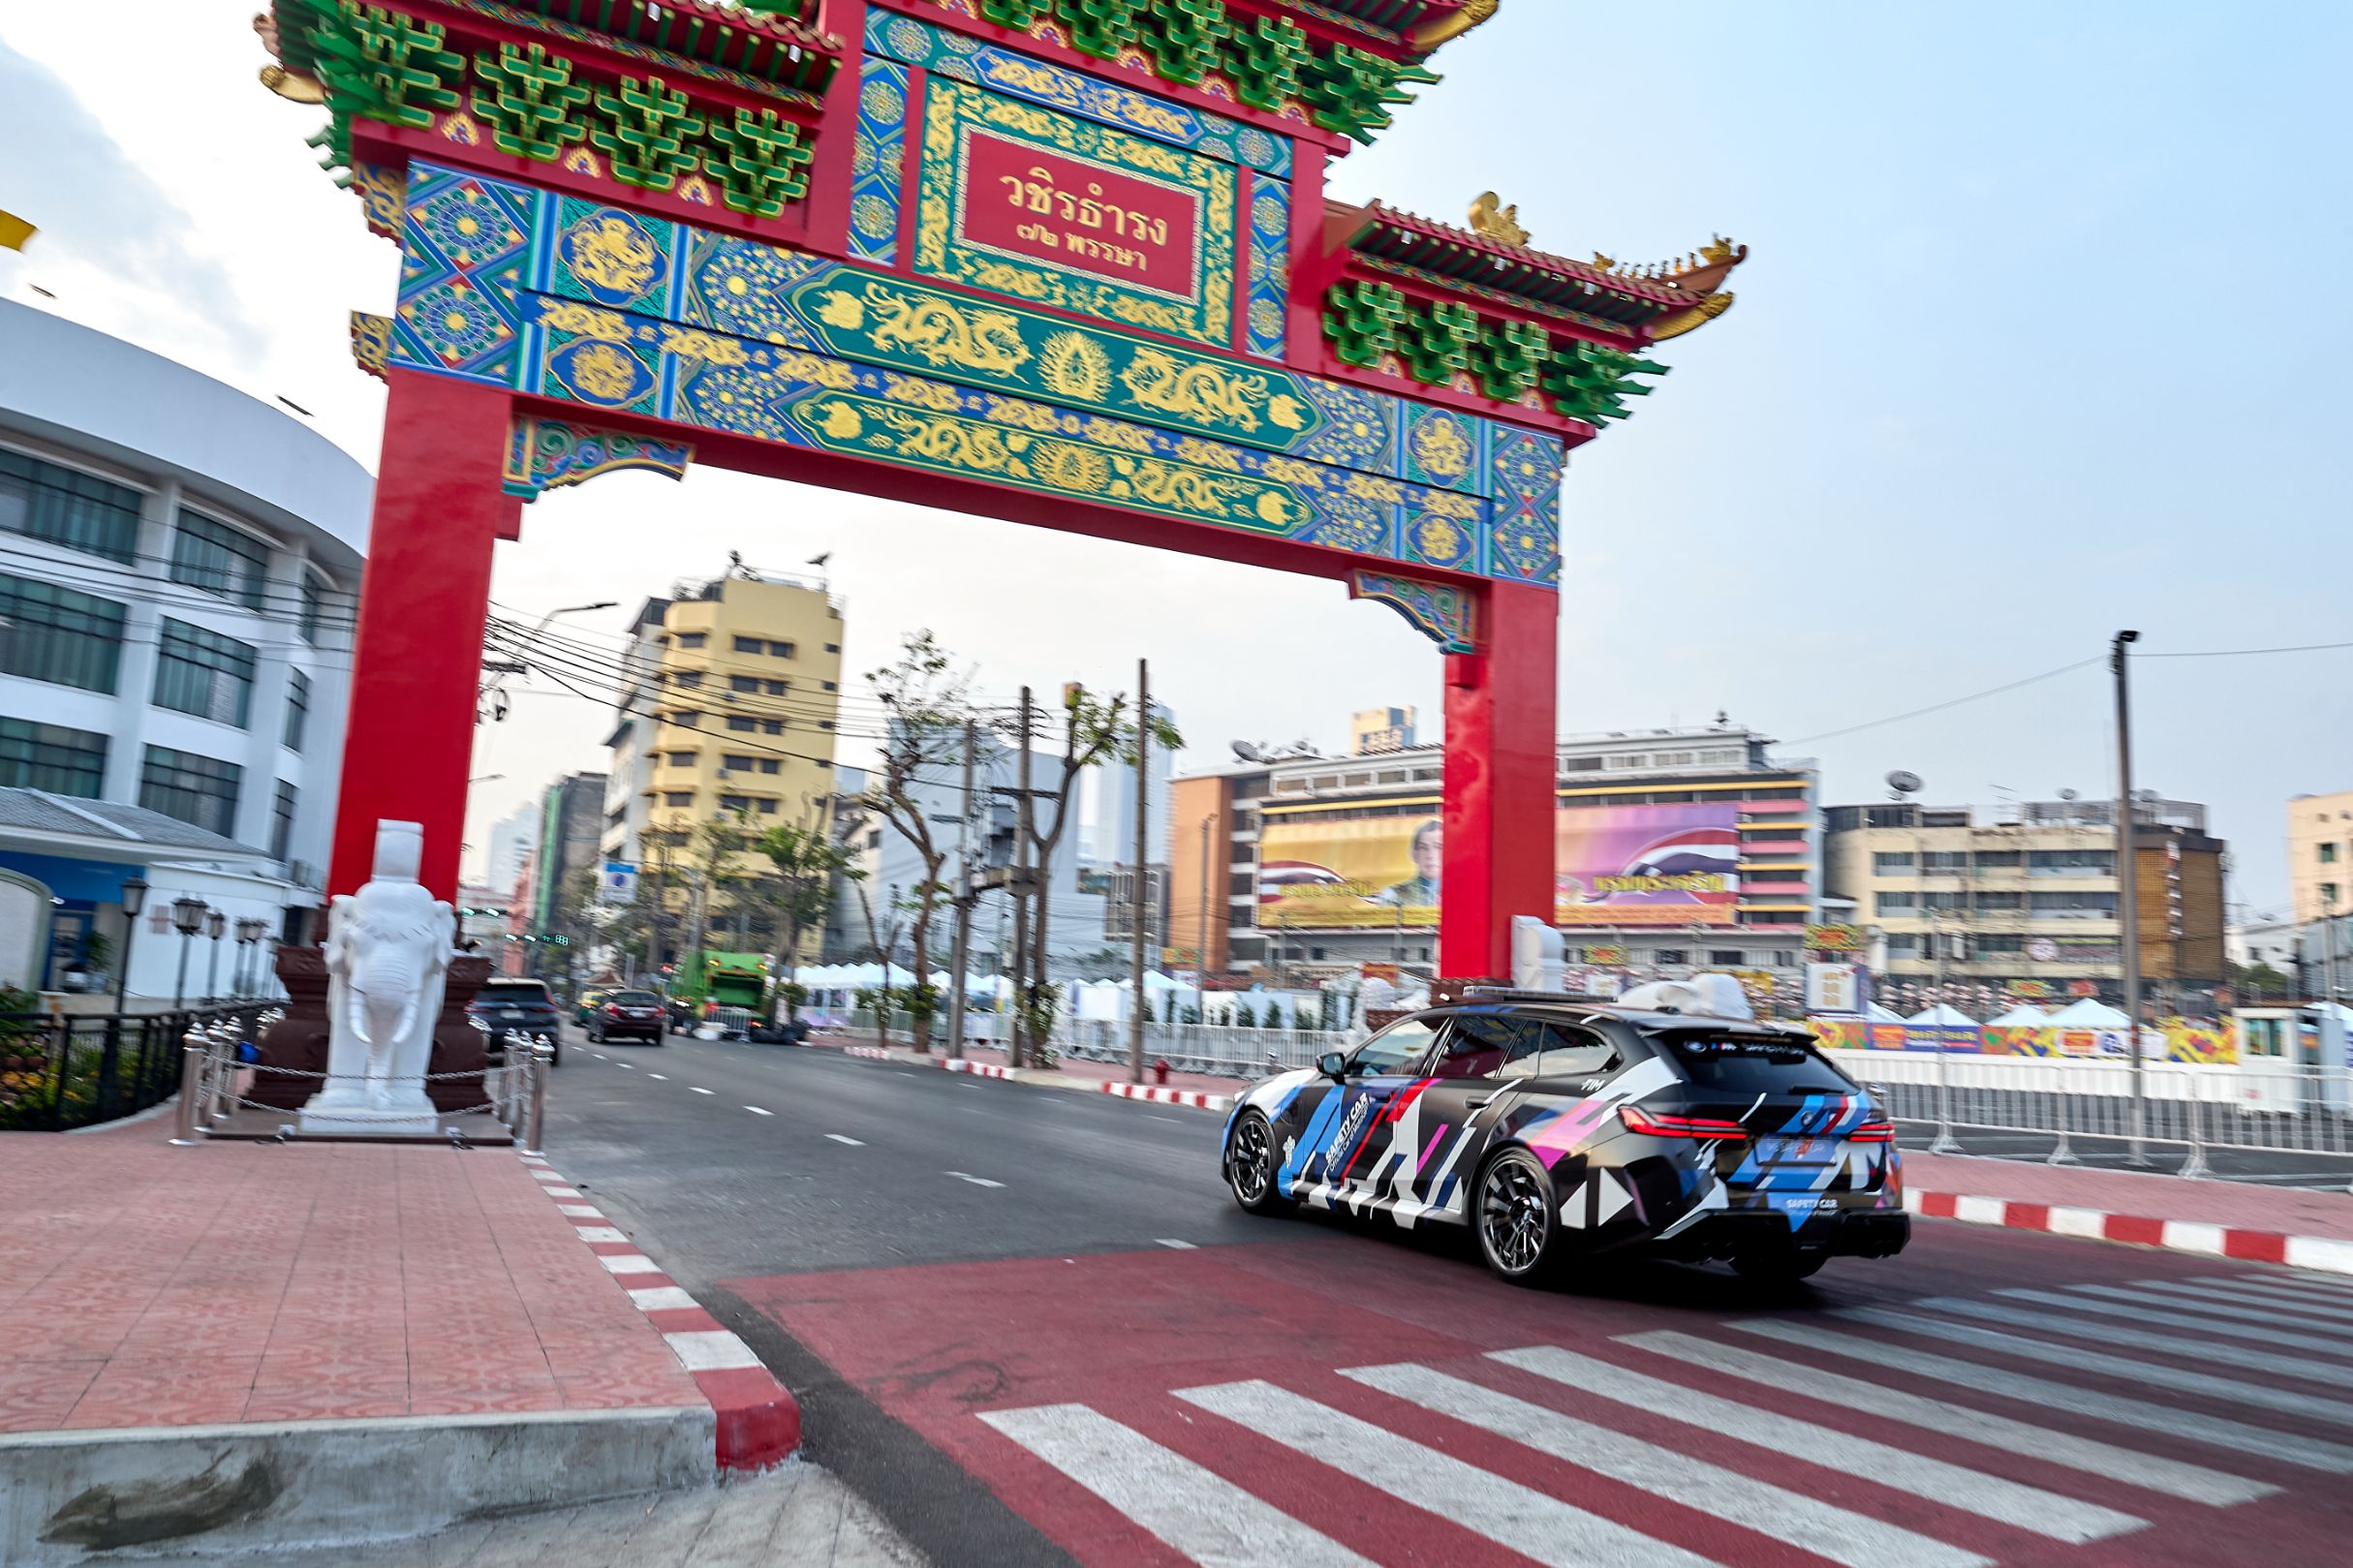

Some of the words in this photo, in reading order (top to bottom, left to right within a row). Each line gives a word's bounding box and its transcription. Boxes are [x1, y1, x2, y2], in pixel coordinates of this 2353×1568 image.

[999, 167, 1168, 246] วชิรธำรง
[1016, 223, 1059, 247] ๗๒
[1065, 231, 1147, 271] พรรษา
[1325, 1115, 1351, 1163] SAFETY
[1350, 1092, 1368, 1120] CAR
